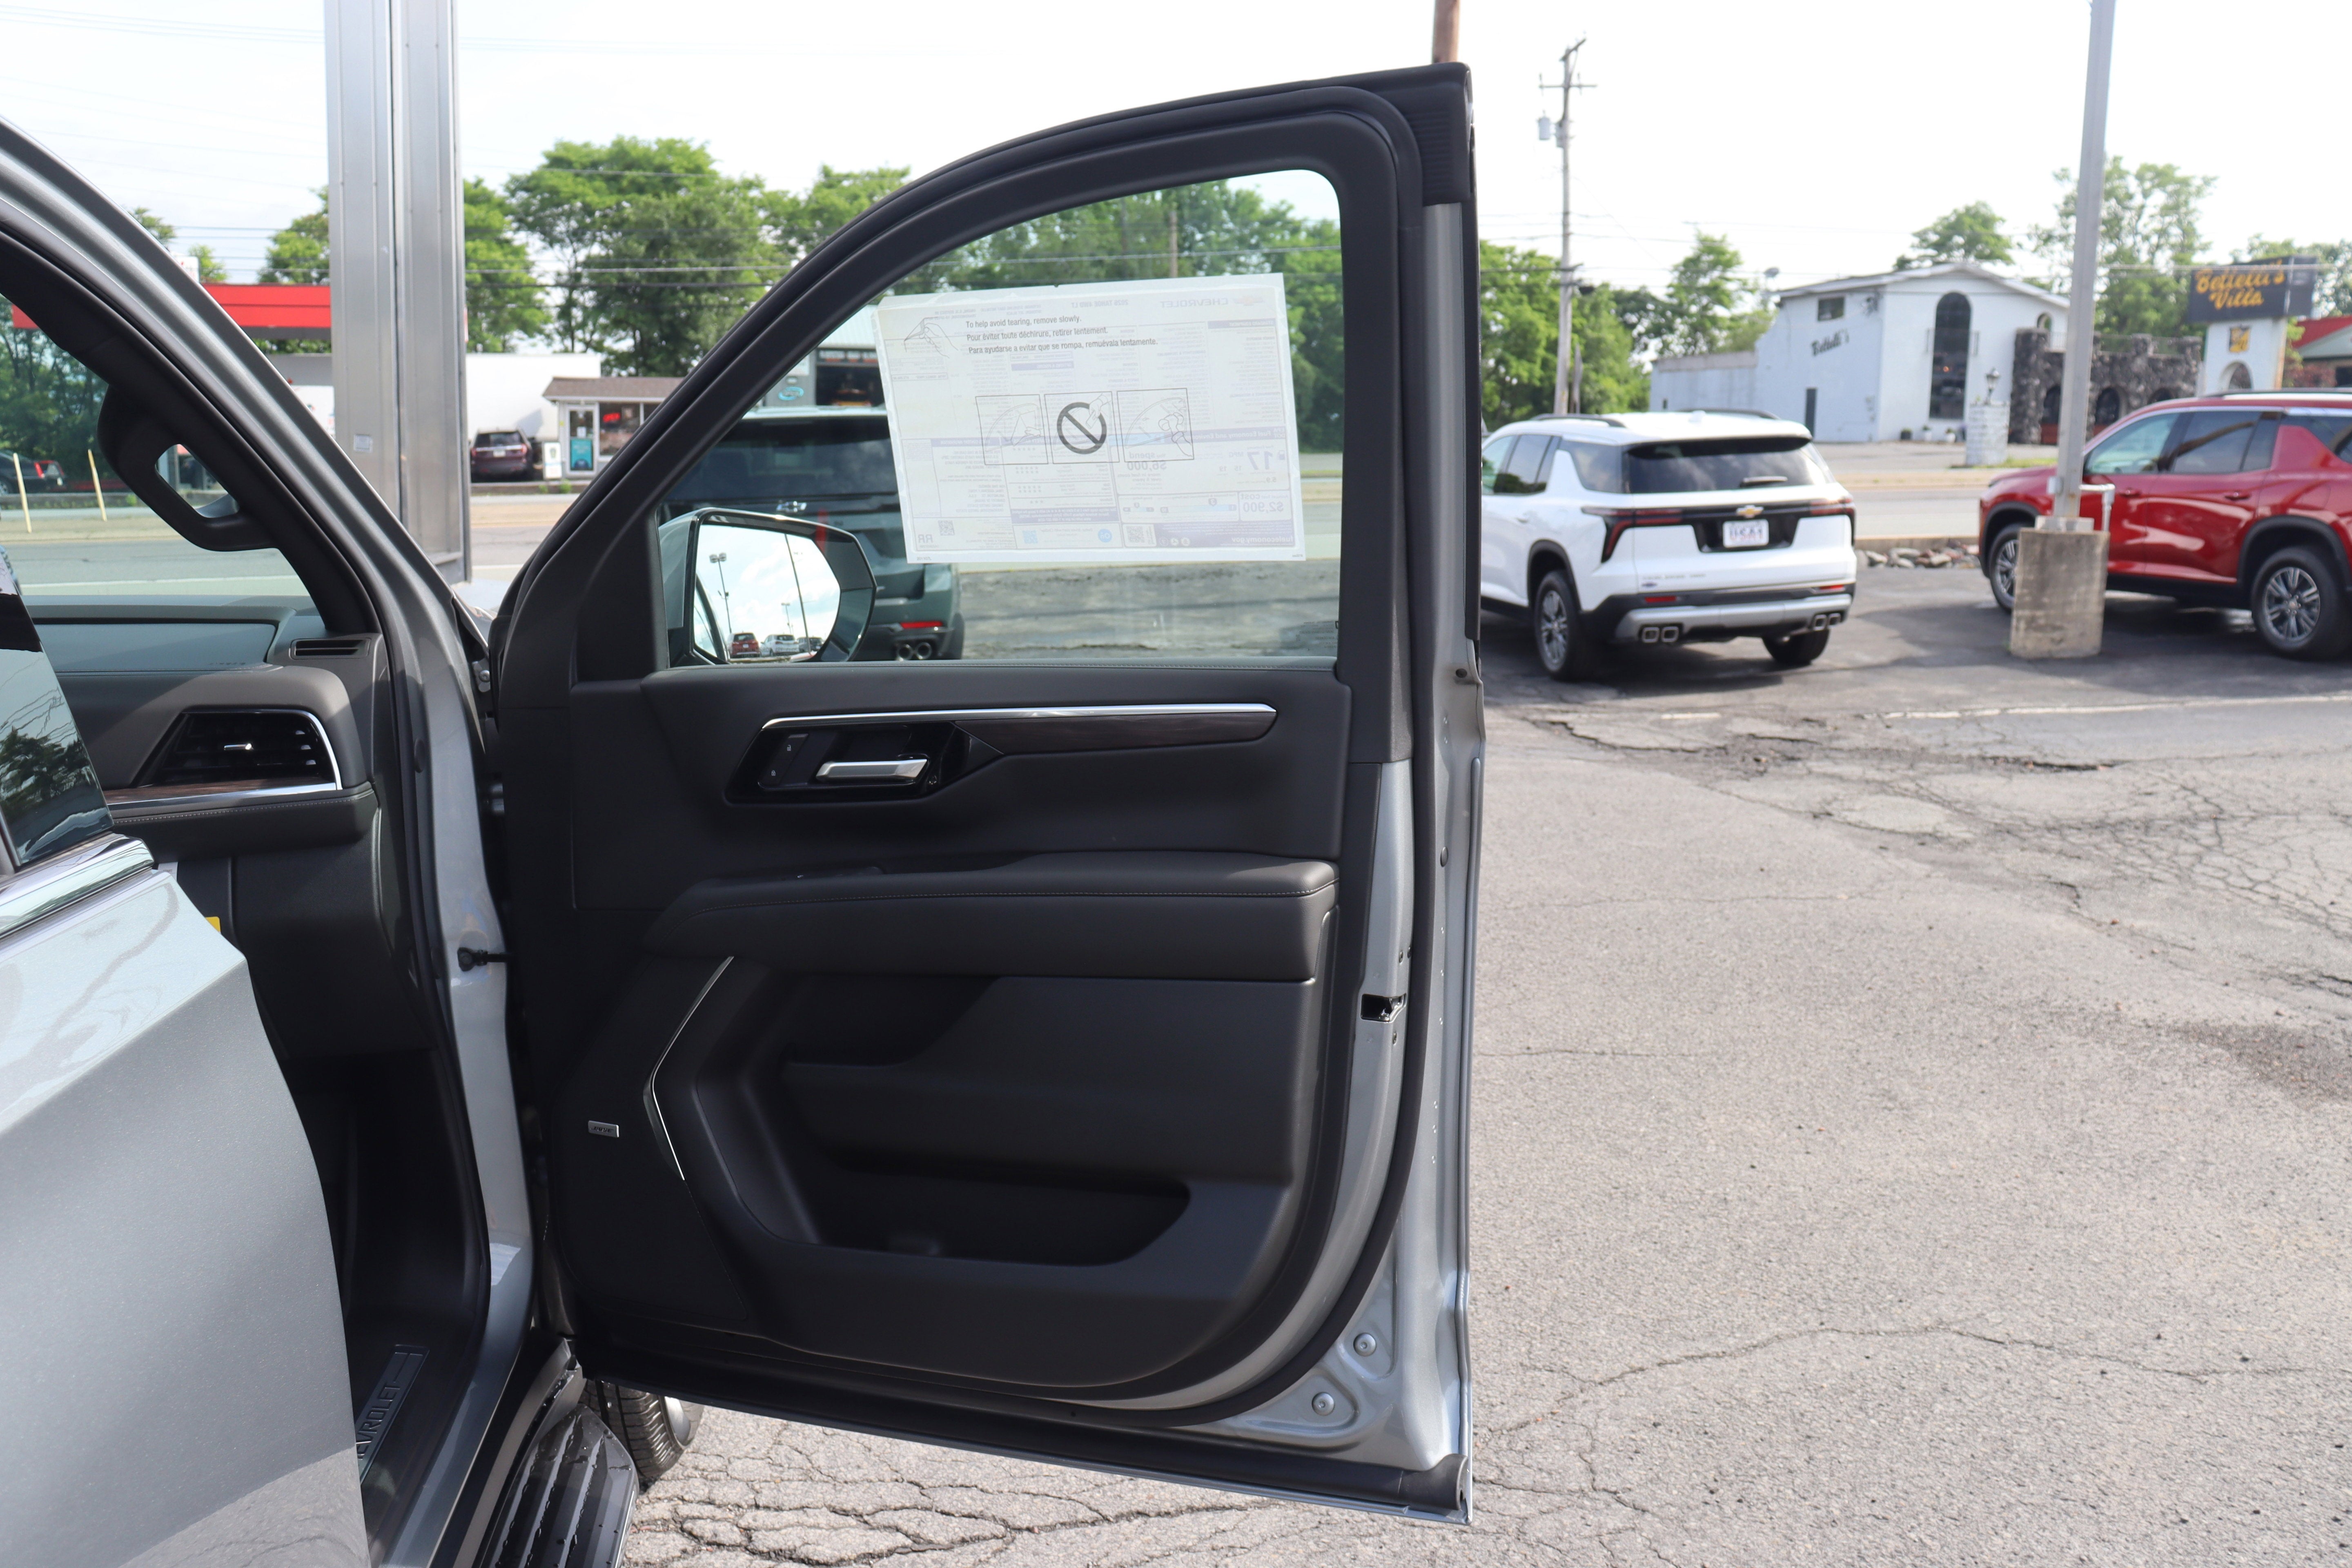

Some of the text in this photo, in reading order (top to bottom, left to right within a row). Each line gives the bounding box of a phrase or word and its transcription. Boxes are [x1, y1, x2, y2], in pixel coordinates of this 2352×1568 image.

[2209, 287, 2264, 310] Villa
[975, 320, 988, 328] help
[1008, 318, 1032, 326] tearing,
[1059, 315, 1082, 323] slowly.
[984, 345, 1012, 354] ayudarse
[1086, 339, 1118, 347] remuévala
[1120, 338, 1158, 346] lentamente.
[356, 1383, 401, 1460] EVROLET
